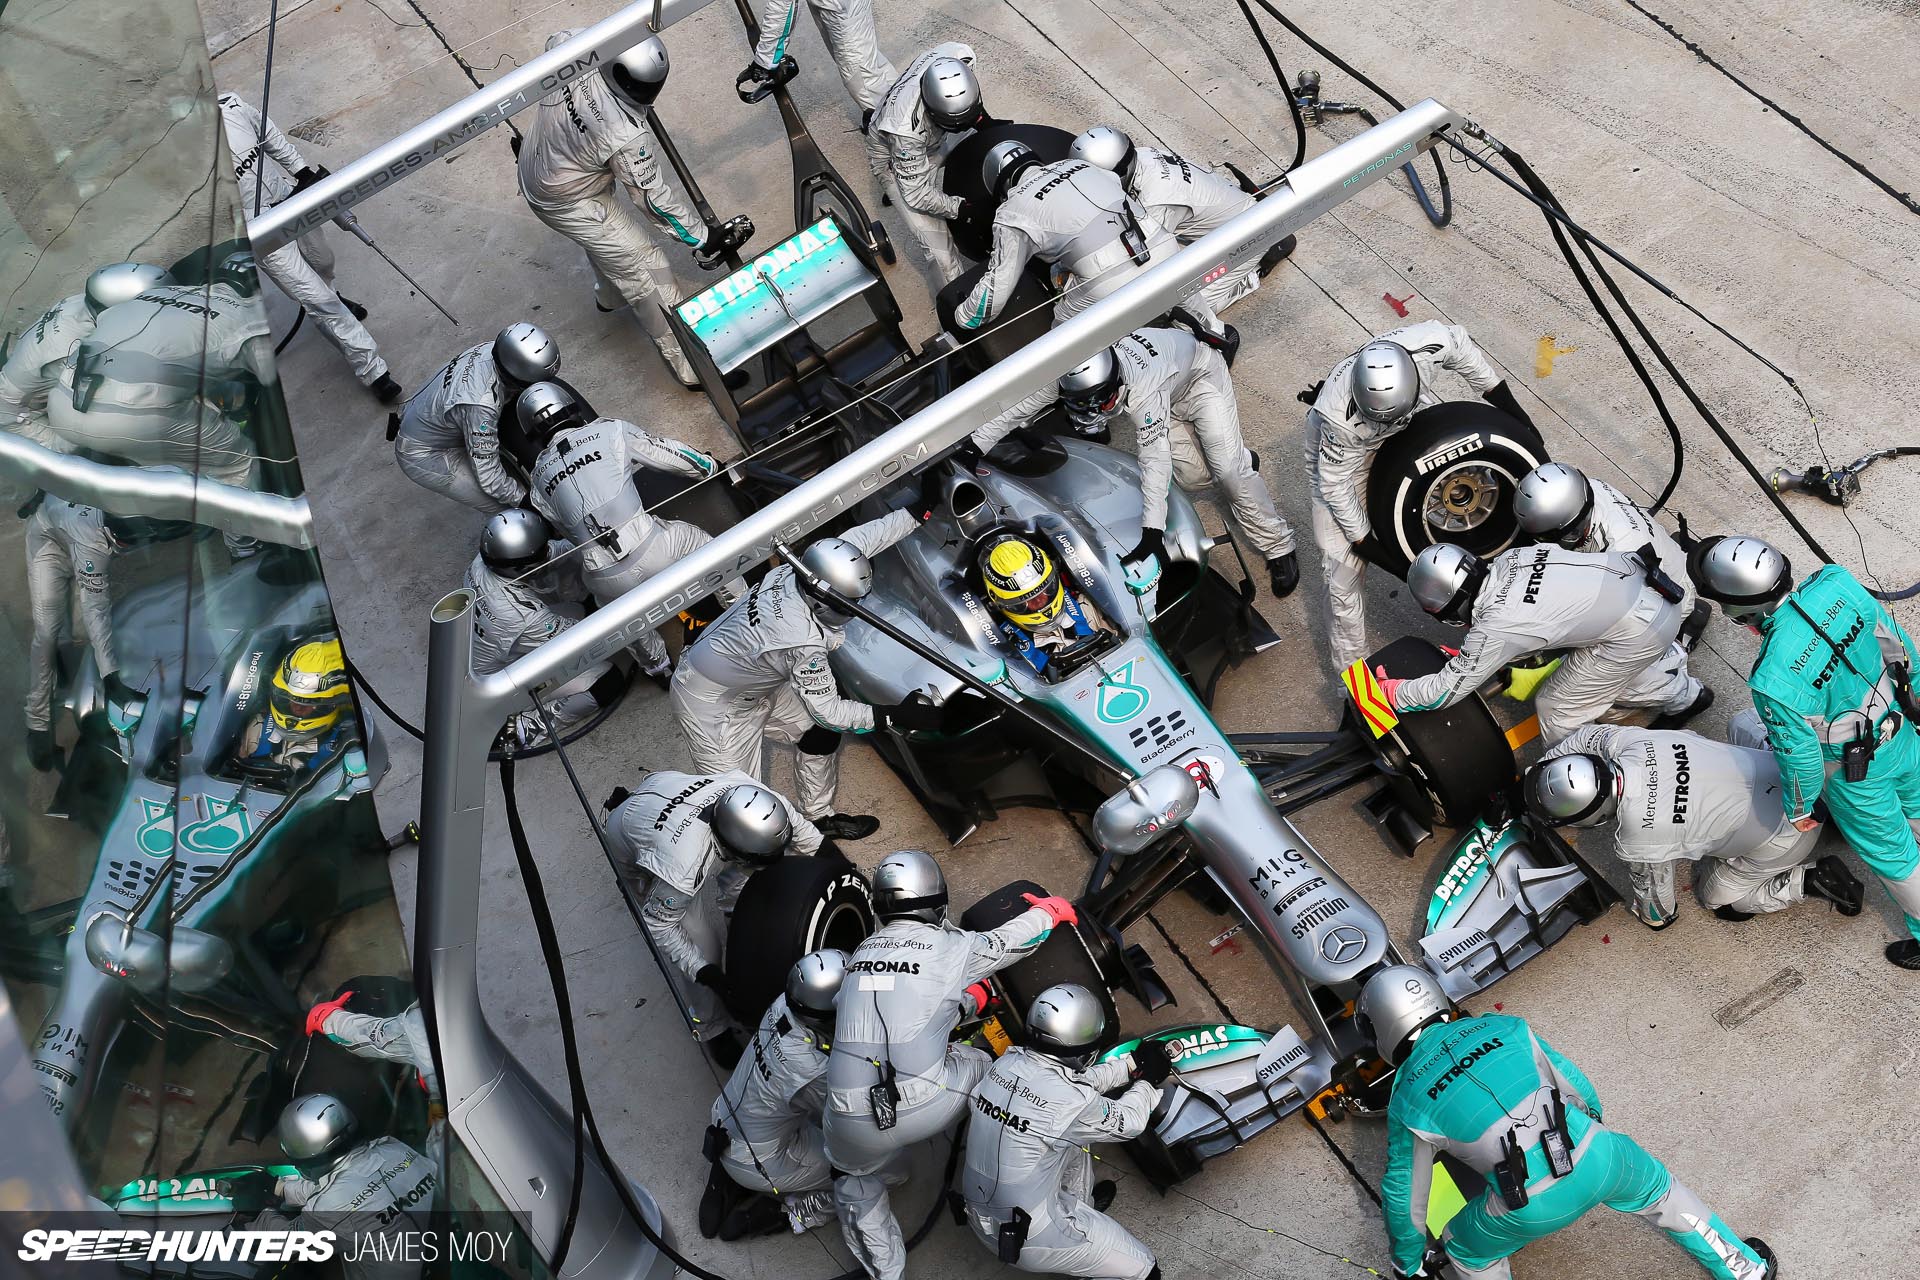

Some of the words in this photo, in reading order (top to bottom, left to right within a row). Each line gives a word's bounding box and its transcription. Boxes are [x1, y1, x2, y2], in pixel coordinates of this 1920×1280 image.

[1343, 142, 1413, 189] PETRONAS
[681, 217, 841, 329] PETRONAS
[544, 451, 602, 497] PETRONAS
[1415, 433, 1484, 476] PIRELLI
[1056, 534, 1090, 580] BlackBerry
[1523, 549, 1551, 605] PETRONAS
[966, 600, 1001, 646] BlackBerry
[800, 667, 826, 675] PETRONAS
[1141, 727, 1196, 764] BlackBerry
[653, 778, 715, 832] PETRONAS
[1642, 741, 1659, 830] Mercedes-Benz
[1672, 743, 1690, 824] PETRONAS
[827, 880, 836, 901] P
[1260, 862, 1313, 900] BANK
[1273, 877, 1328, 917] PIRELLI
[1291, 897, 1350, 940] SYNTIUM
[1297, 898, 1328, 919] PETRONAS
[1438, 930, 1487, 964] SYNTIUM
[1259, 1045, 1306, 1080] SYNTIUM
[1407, 1021, 1490, 1086] Mercedes-Benz
[1427, 1037, 1504, 1101] PETRONAS
